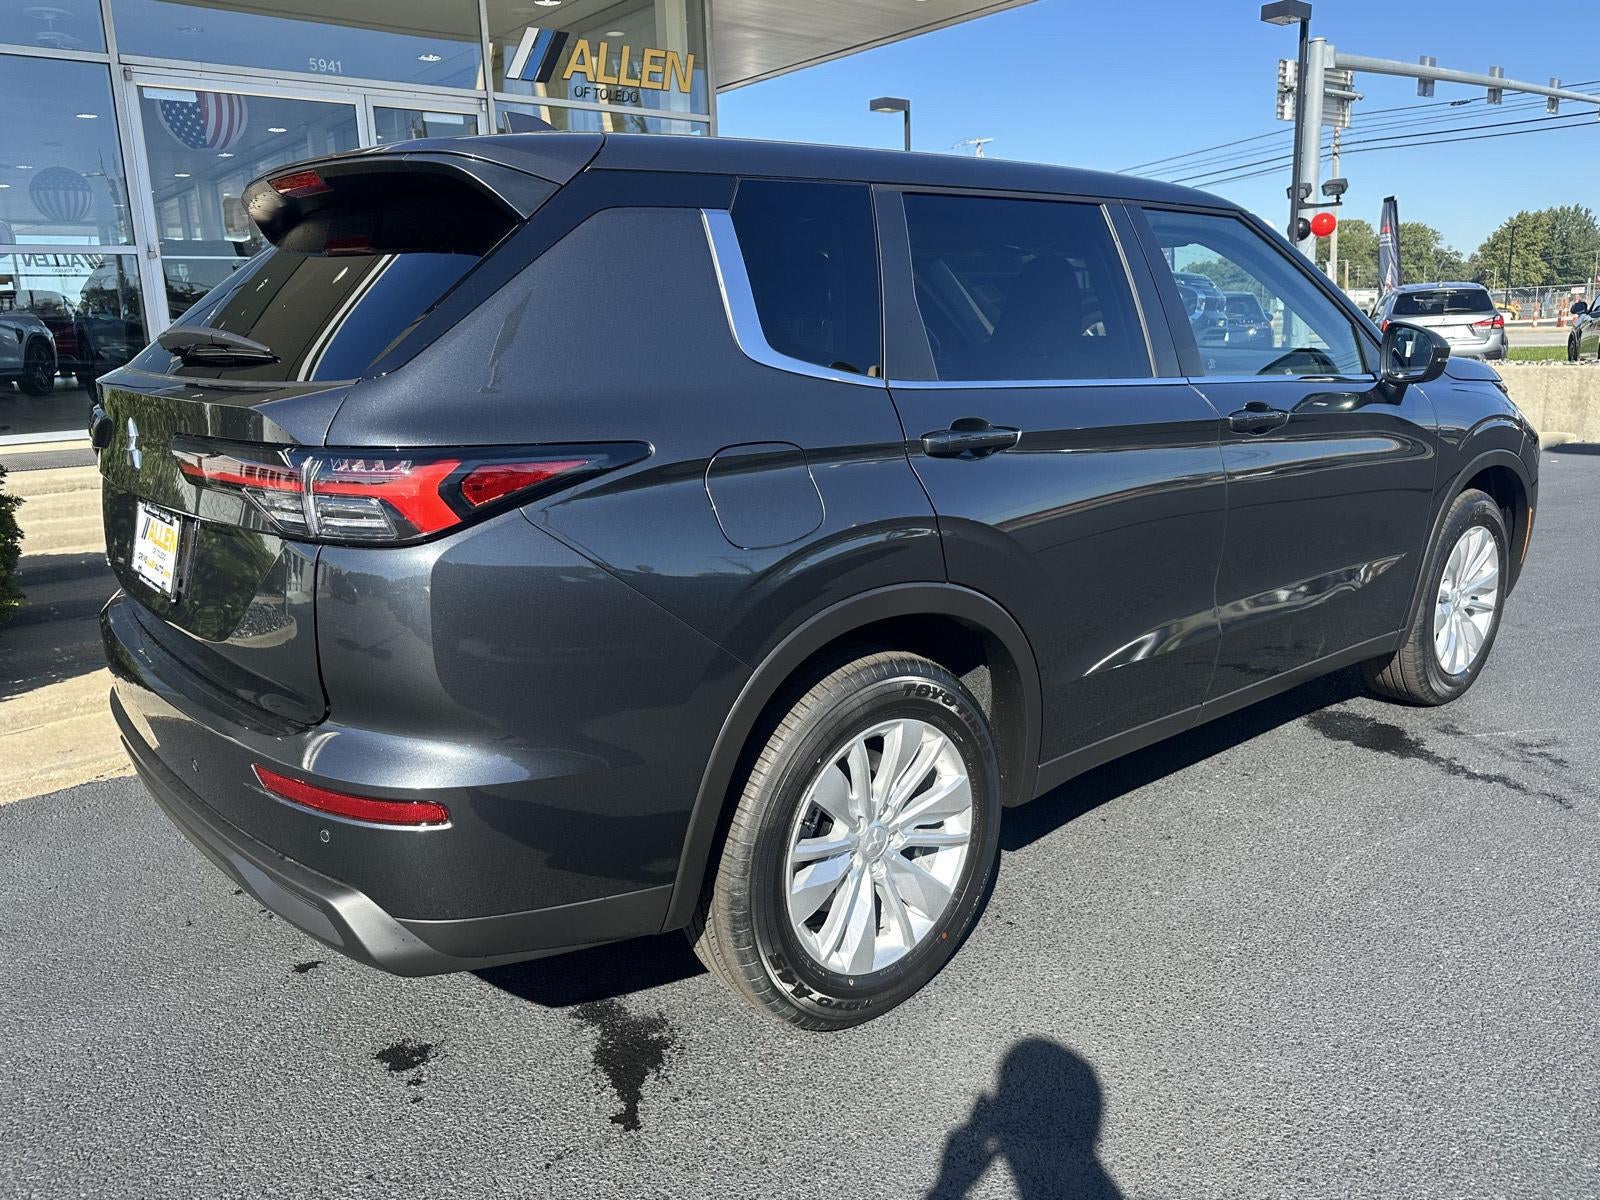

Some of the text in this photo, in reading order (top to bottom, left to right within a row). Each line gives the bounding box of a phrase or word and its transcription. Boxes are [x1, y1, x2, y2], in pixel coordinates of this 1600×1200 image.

[309, 57, 342, 74] 5941
[562, 38, 695, 93] ALLEN
[574, 85, 639, 103] OF TOLEDO
[147, 517, 177, 555] ALLEN
[902, 683, 957, 707] TOYO
